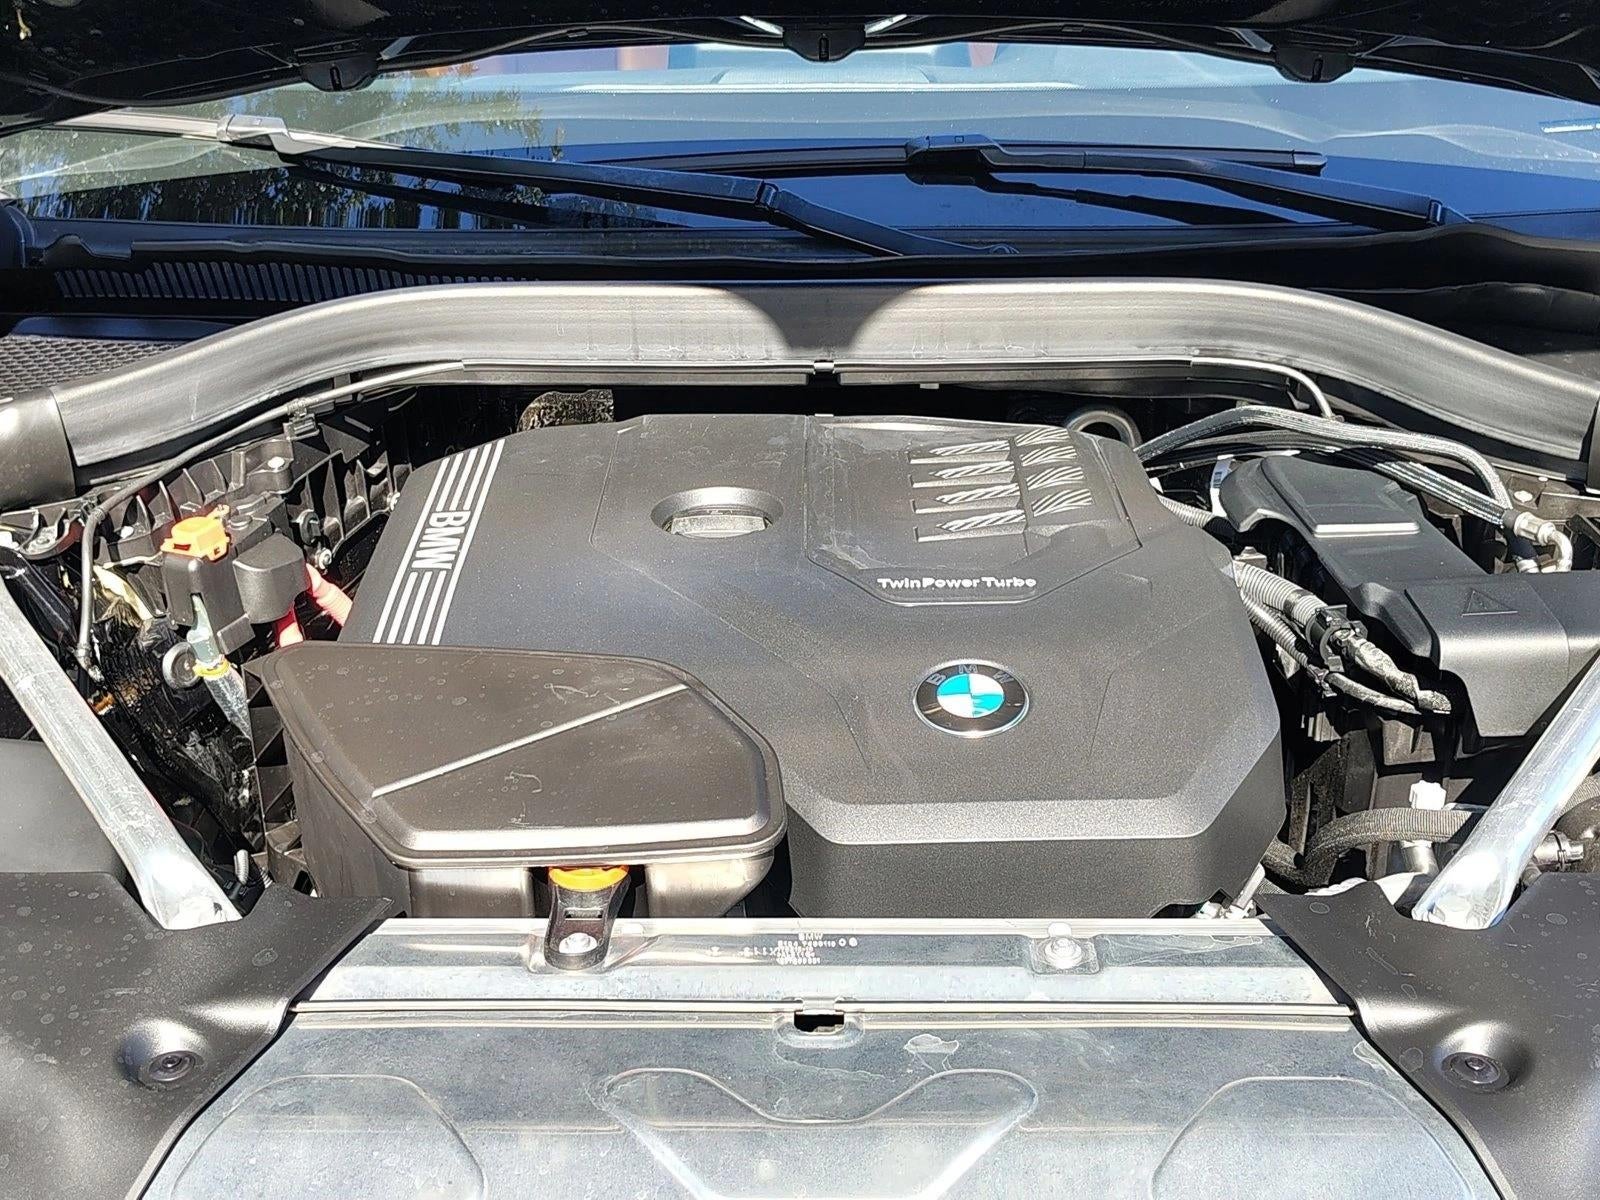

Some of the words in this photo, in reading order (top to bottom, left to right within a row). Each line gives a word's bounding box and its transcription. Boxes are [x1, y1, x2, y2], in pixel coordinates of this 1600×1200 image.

[411, 510, 471, 570] BMW
[877, 577, 980, 589] TwinPower
[981, 577, 1037, 588] Turbo
[925, 664, 1015, 686] BMW
